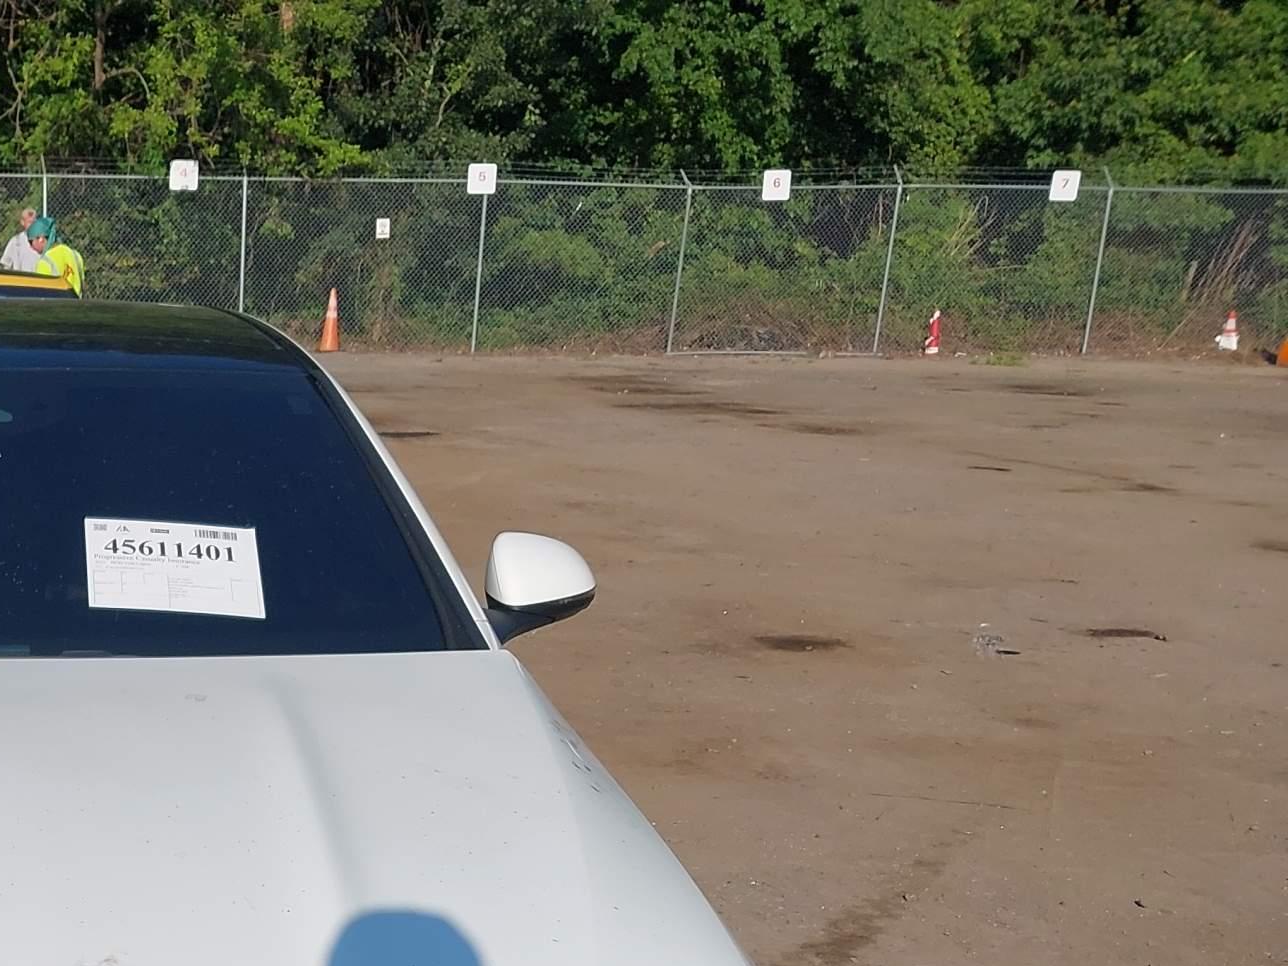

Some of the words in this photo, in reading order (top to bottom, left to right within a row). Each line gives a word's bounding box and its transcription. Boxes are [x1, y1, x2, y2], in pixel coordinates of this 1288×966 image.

[478, 171, 486, 182] 5
[773, 178, 781, 188] 6
[1062, 178, 1071, 189] 7
[103, 538, 237, 563] 45611401
